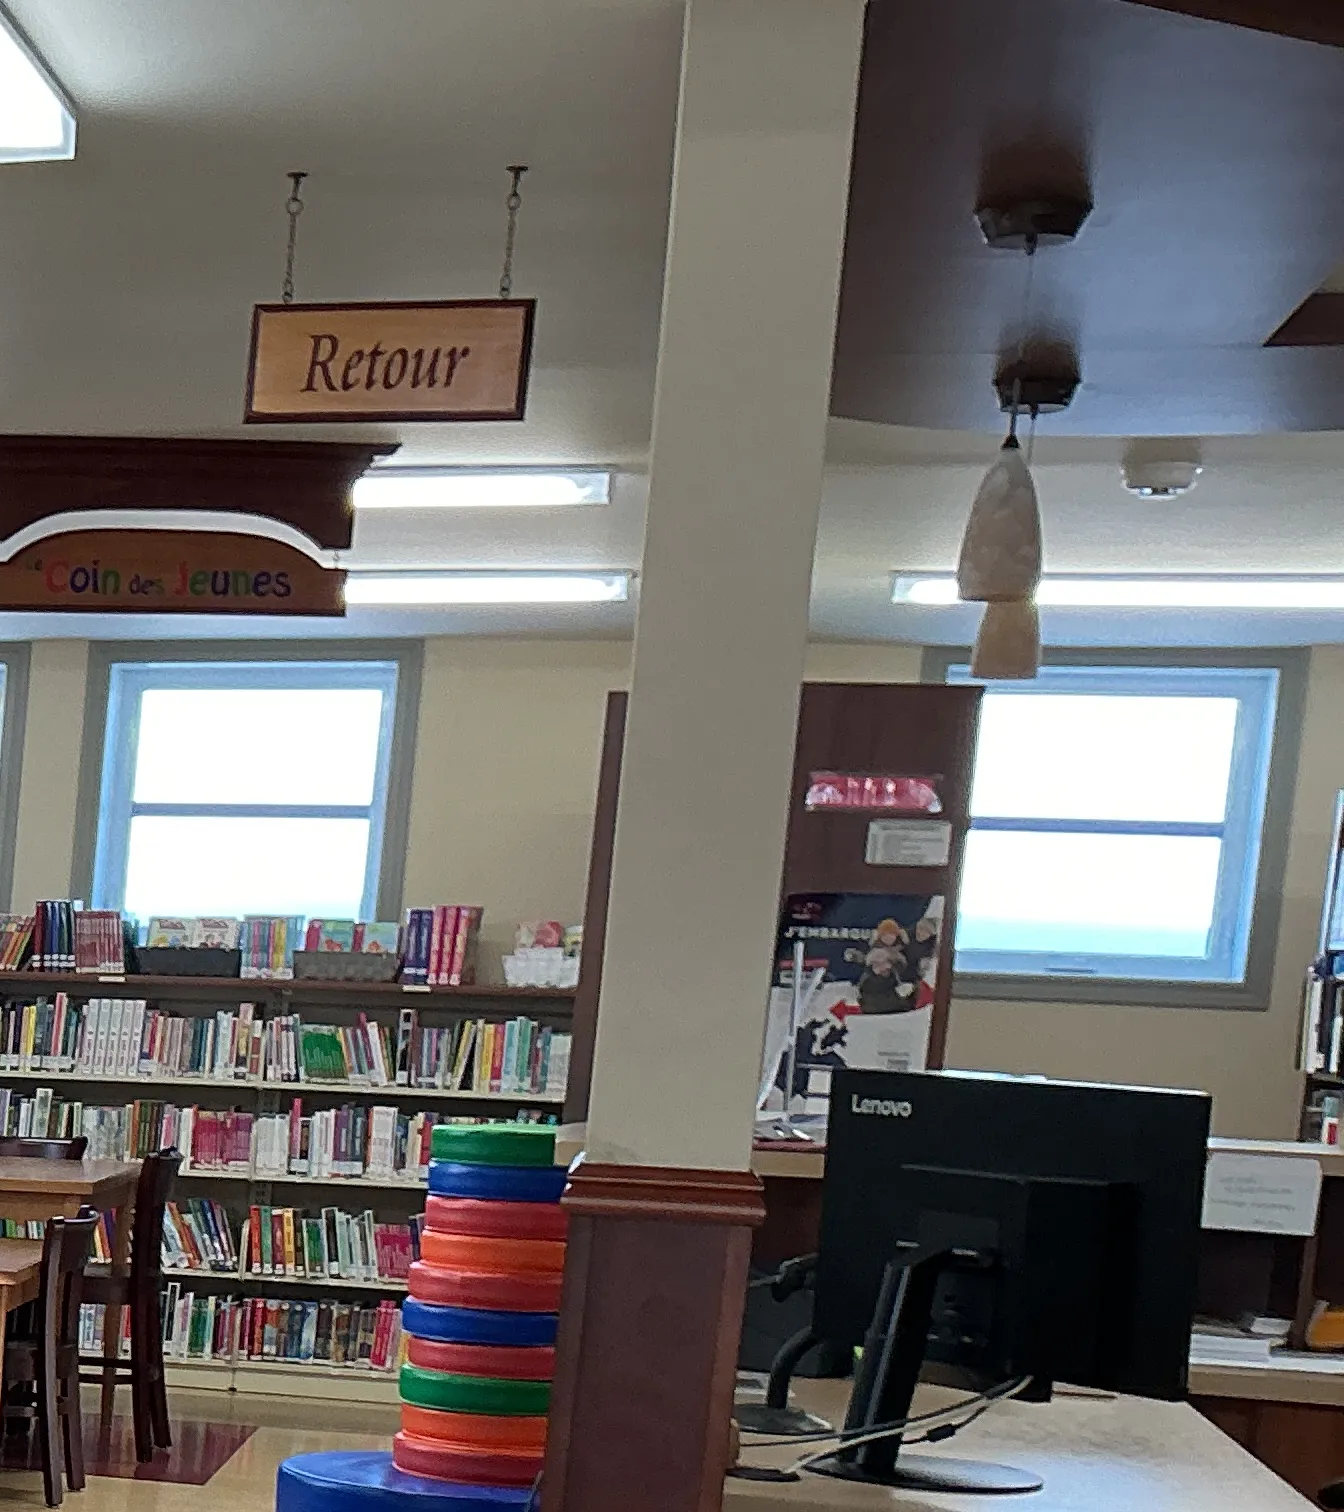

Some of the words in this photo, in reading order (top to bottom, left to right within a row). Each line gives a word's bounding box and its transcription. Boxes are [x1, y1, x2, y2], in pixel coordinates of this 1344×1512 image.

[300, 334, 470, 393] Retour
[44, 556, 122, 594] Coin
[129, 574, 164, 596] des
[173, 561, 293, 598] Jeunes
[851, 1093, 913, 1119] Lenovo
